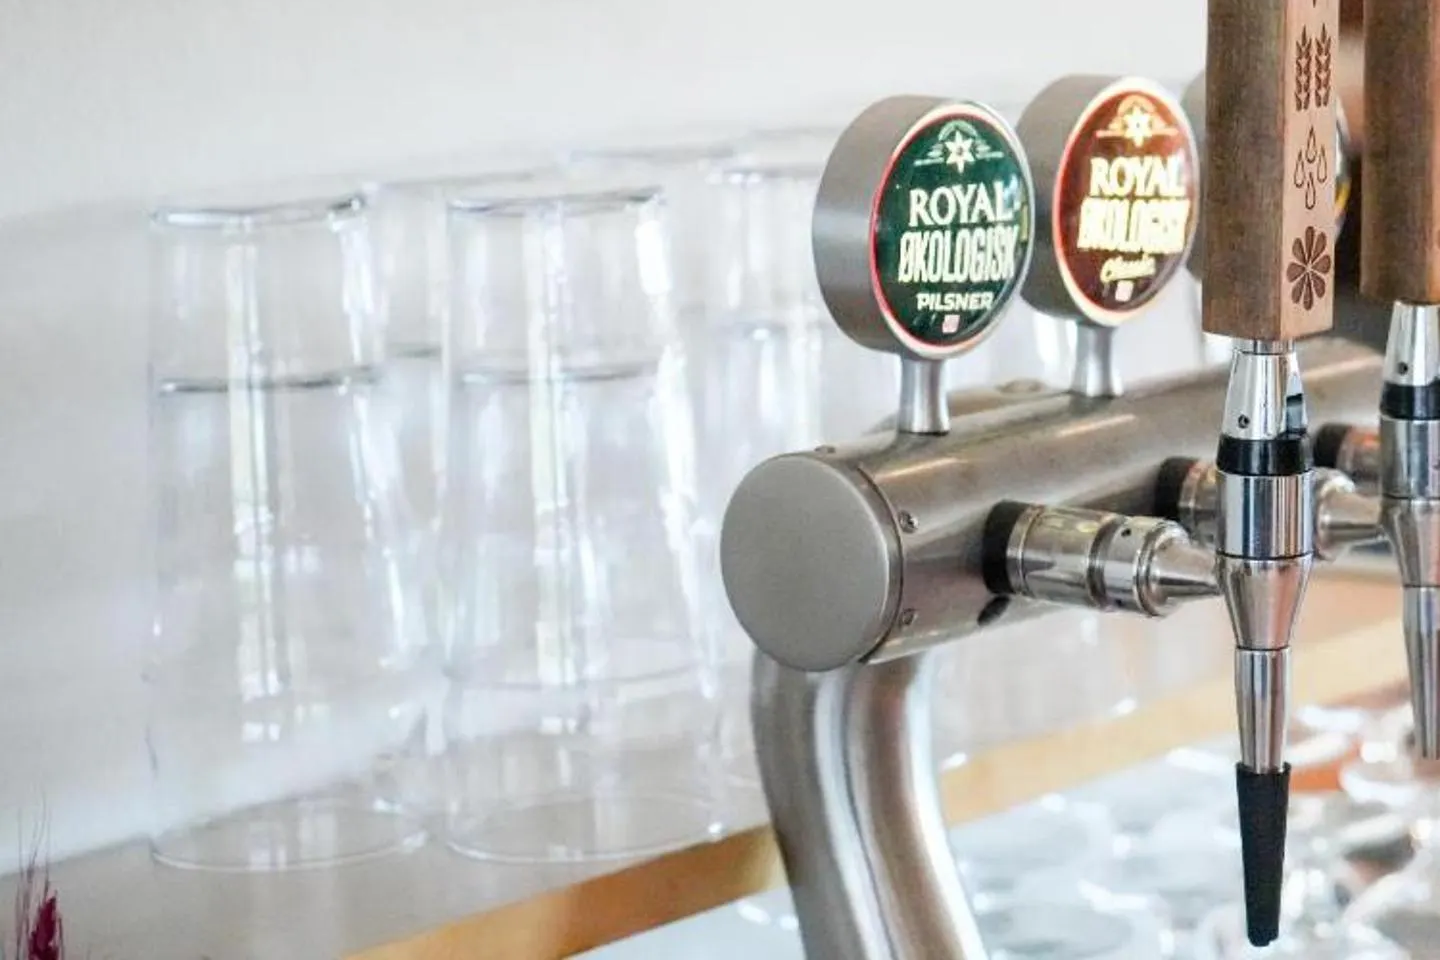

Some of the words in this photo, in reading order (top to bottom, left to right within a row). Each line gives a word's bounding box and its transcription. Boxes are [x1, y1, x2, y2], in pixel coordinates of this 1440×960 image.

[1089, 155, 1187, 196] ROYAL
[908, 181, 1014, 227] ROYAL
[898, 223, 1019, 283] ØKOLOGISK
[916, 292, 994, 310] PILSNER
